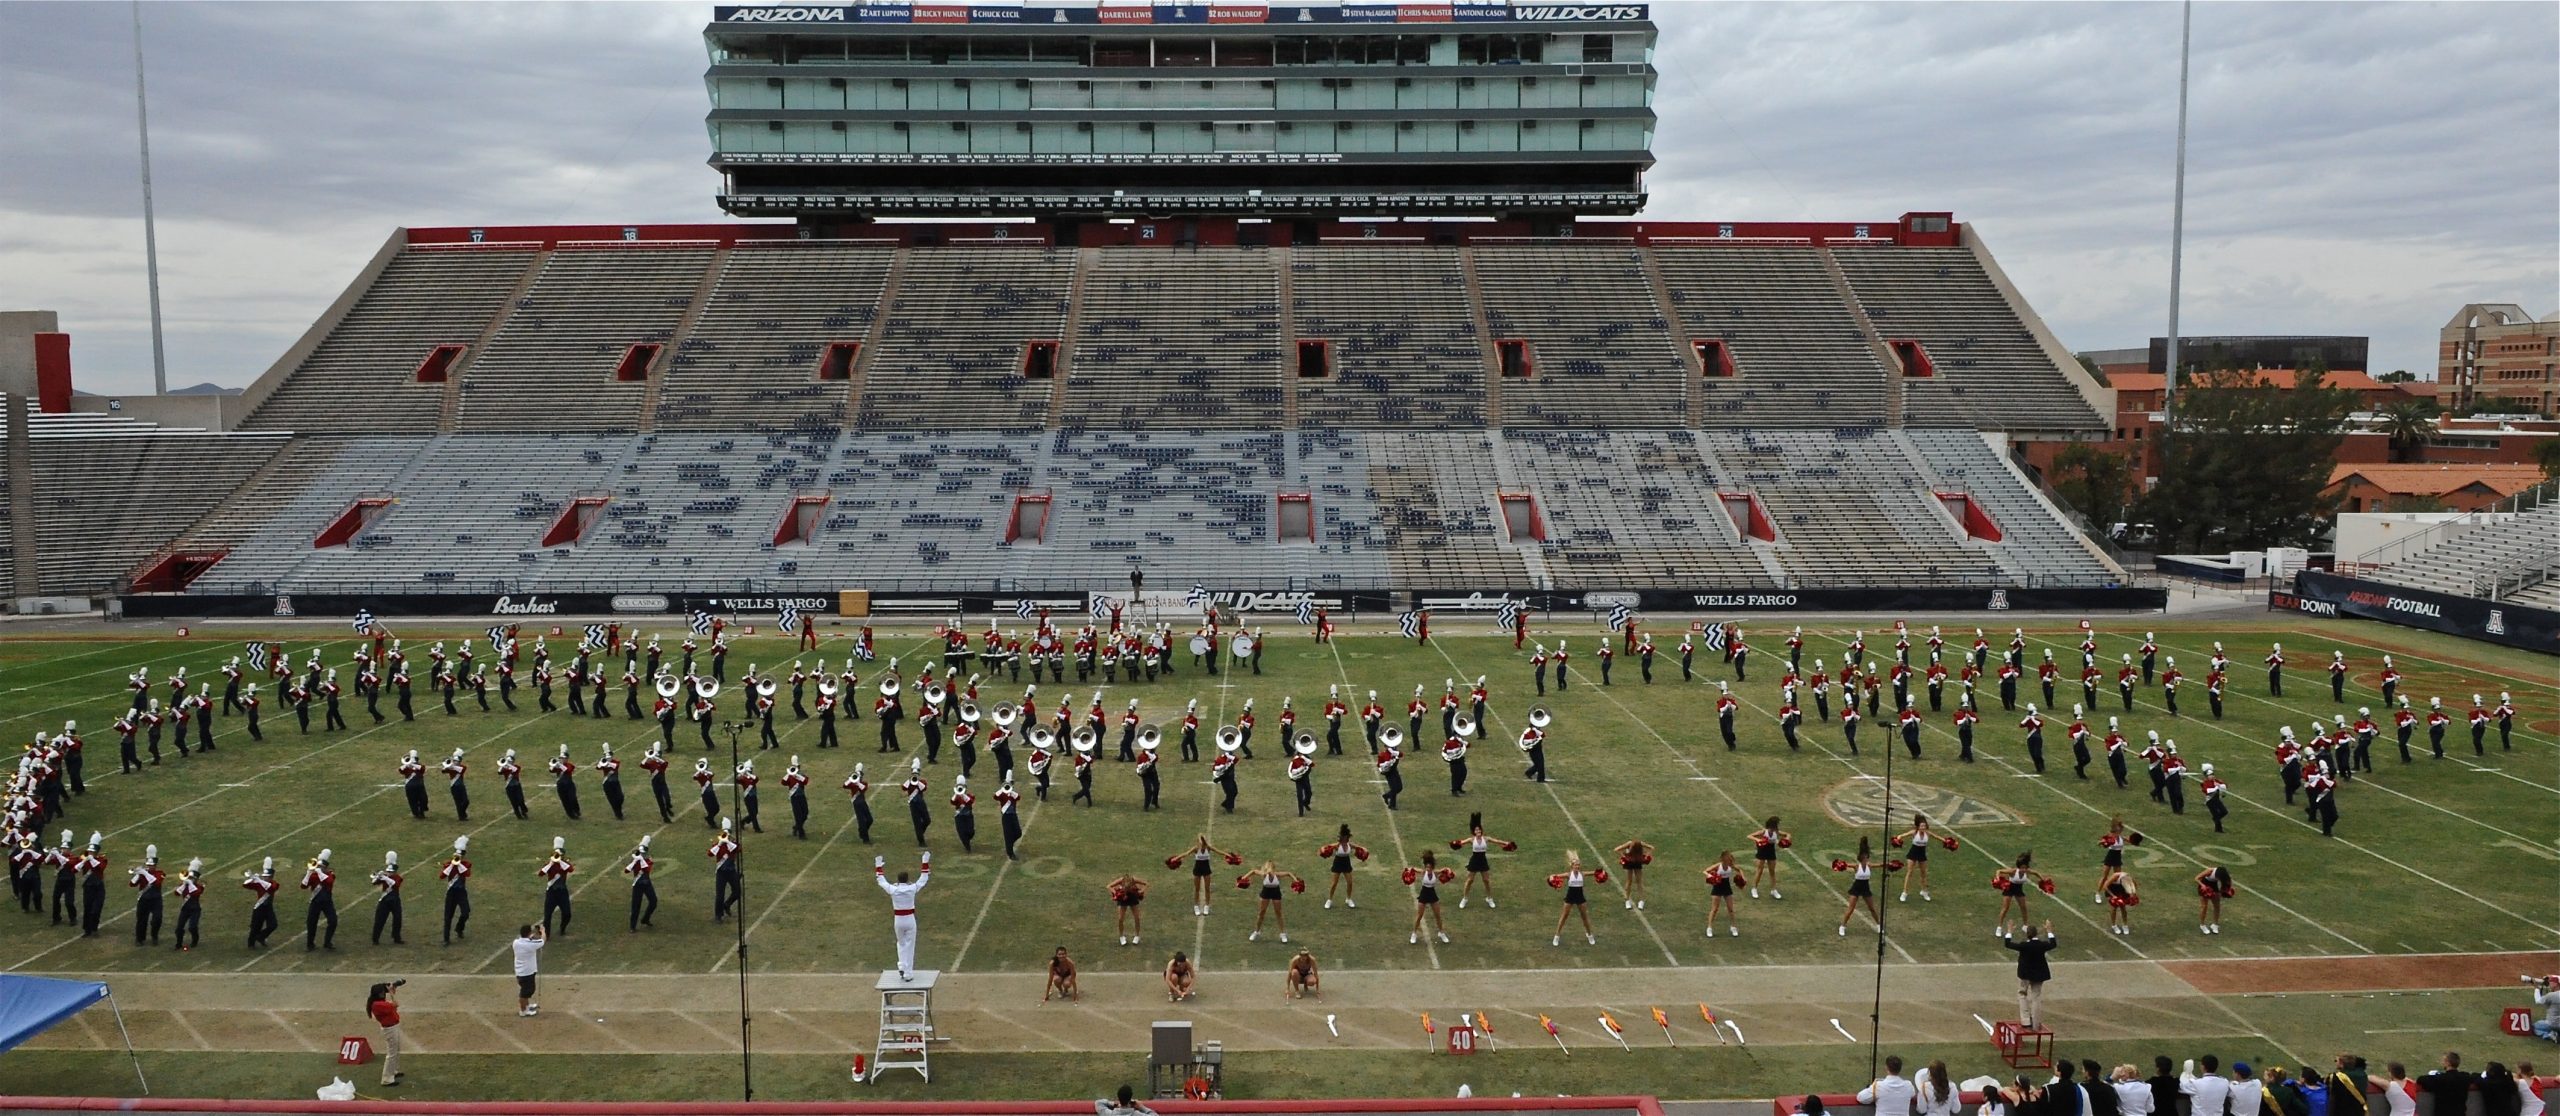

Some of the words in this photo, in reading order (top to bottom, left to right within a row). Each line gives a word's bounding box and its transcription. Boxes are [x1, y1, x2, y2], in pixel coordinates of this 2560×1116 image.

[727, 8, 845, 21] ARIZONA
[859, 9, 868, 17] 22
[868, 9, 881, 17] ART
[882, 9, 910, 17] LUPPINO
[922, 9, 942, 17] RICKY
[943, 9, 967, 17] HUNLEY
[978, 10, 1000, 18] CHUCK
[1001, 10, 1020, 18] CECIL
[1098, 11, 1103, 19] 4
[1103, 11, 1131, 19] DARRYLL
[1132, 11, 1152, 19] LEWIS
[1217, 10, 1231, 18] ROB
[1231, 10, 1263, 18] WALDROP
[1350, 9, 1365, 17] STEVE
[1365, 9, 1396, 17] McLAUGHLIN
[1398, 8, 1403, 17] 11
[1403, 9, 1421, 17] CHRIS
[1422, 9, 1452, 17] McALISTER
[1458, 9, 1484, 17] ANTOINE
[1485, 9, 1507, 17] CASON
[1515, 7, 1642, 20] WILDCATS
[472, 234, 483, 242] 17
[624, 232, 636, 241] 18
[799, 231, 810, 240] 19
[994, 230, 1008, 239] 20
[1142, 229, 1154, 239] 21
[1364, 229, 1377, 238] 22
[1560, 229, 1573, 238] 23
[1719, 229, 1732, 239] 24
[1856, 229, 1869, 239] 25
[110, 401, 120, 410] 16
[492, 596, 558, 614] Bashas'
[722, 598, 774, 609] WELLS
[777, 598, 827, 609] FARGO
[1693, 595, 1745, 606] WELLS
[1747, 595, 1798, 606] FARGO
[2300, 598, 2336, 616] DOWN
[2386, 597, 2441, 617] FOOTBALL
[2510, 1013, 2530, 1032] 20
[1452, 1030, 1471, 1050] 40
[341, 1041, 360, 1060] 40
